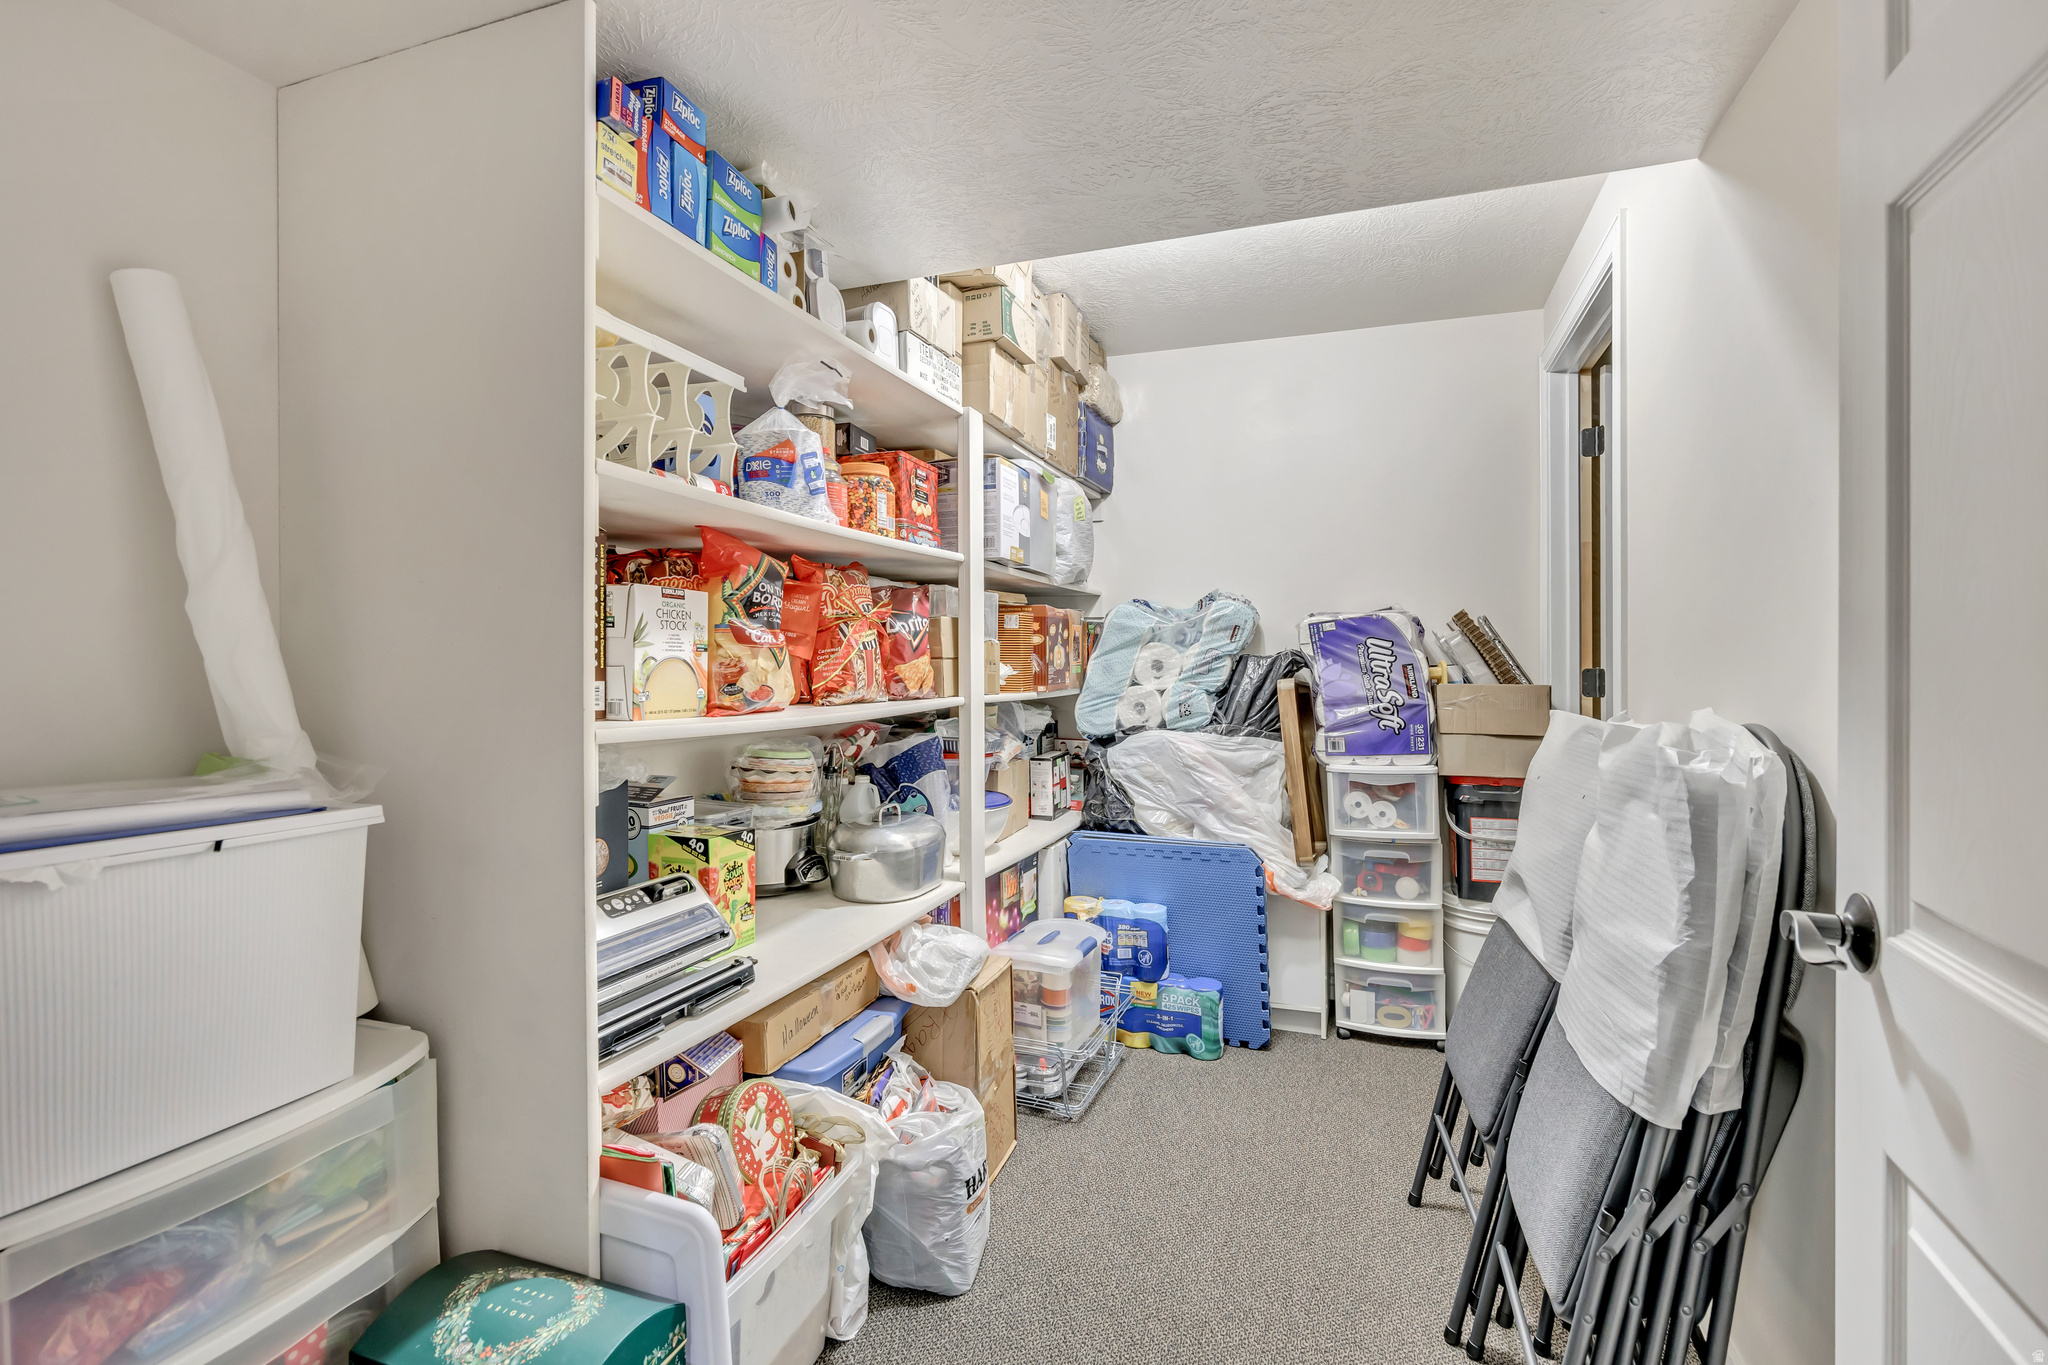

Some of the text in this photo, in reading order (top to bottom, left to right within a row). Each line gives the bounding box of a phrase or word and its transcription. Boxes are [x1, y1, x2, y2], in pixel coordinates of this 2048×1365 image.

[673, 94, 701, 130] Ziploc
[641, 117, 650, 153] STORAGE
[656, 152, 670, 200] Ziploc
[681, 168, 695, 213] Ziploc
[728, 169, 753, 200] Ziploc
[723, 214, 752, 241] Ziploc
[766, 249, 776, 288] Ziploc
[759, 582, 774, 592] ON
[661, 601, 686, 610] ORGANIC
[752, 591, 783, 611] BORD
[655, 608, 692, 620] CHICKEN
[660, 619, 688, 631] STOCK
[1407, 664, 1419, 699] KIRKLAND
[1417, 723, 1425, 734] 36
[1417, 737, 1425, 751] 231
[671, 803, 684, 813] FRUIT
[654, 813, 673, 822] VEGGIE
[741, 830, 754, 843] 40
[688, 838, 705, 854] 40
[725, 866, 744, 881] SOUR
[723, 876, 745, 892] PATCH
[1162, 993, 1169, 1002] 5
[1170, 993, 1200, 1008] PACK
[1177, 1004, 1200, 1014] WIPES
[486, 1303, 535, 1321] BRIGHT
